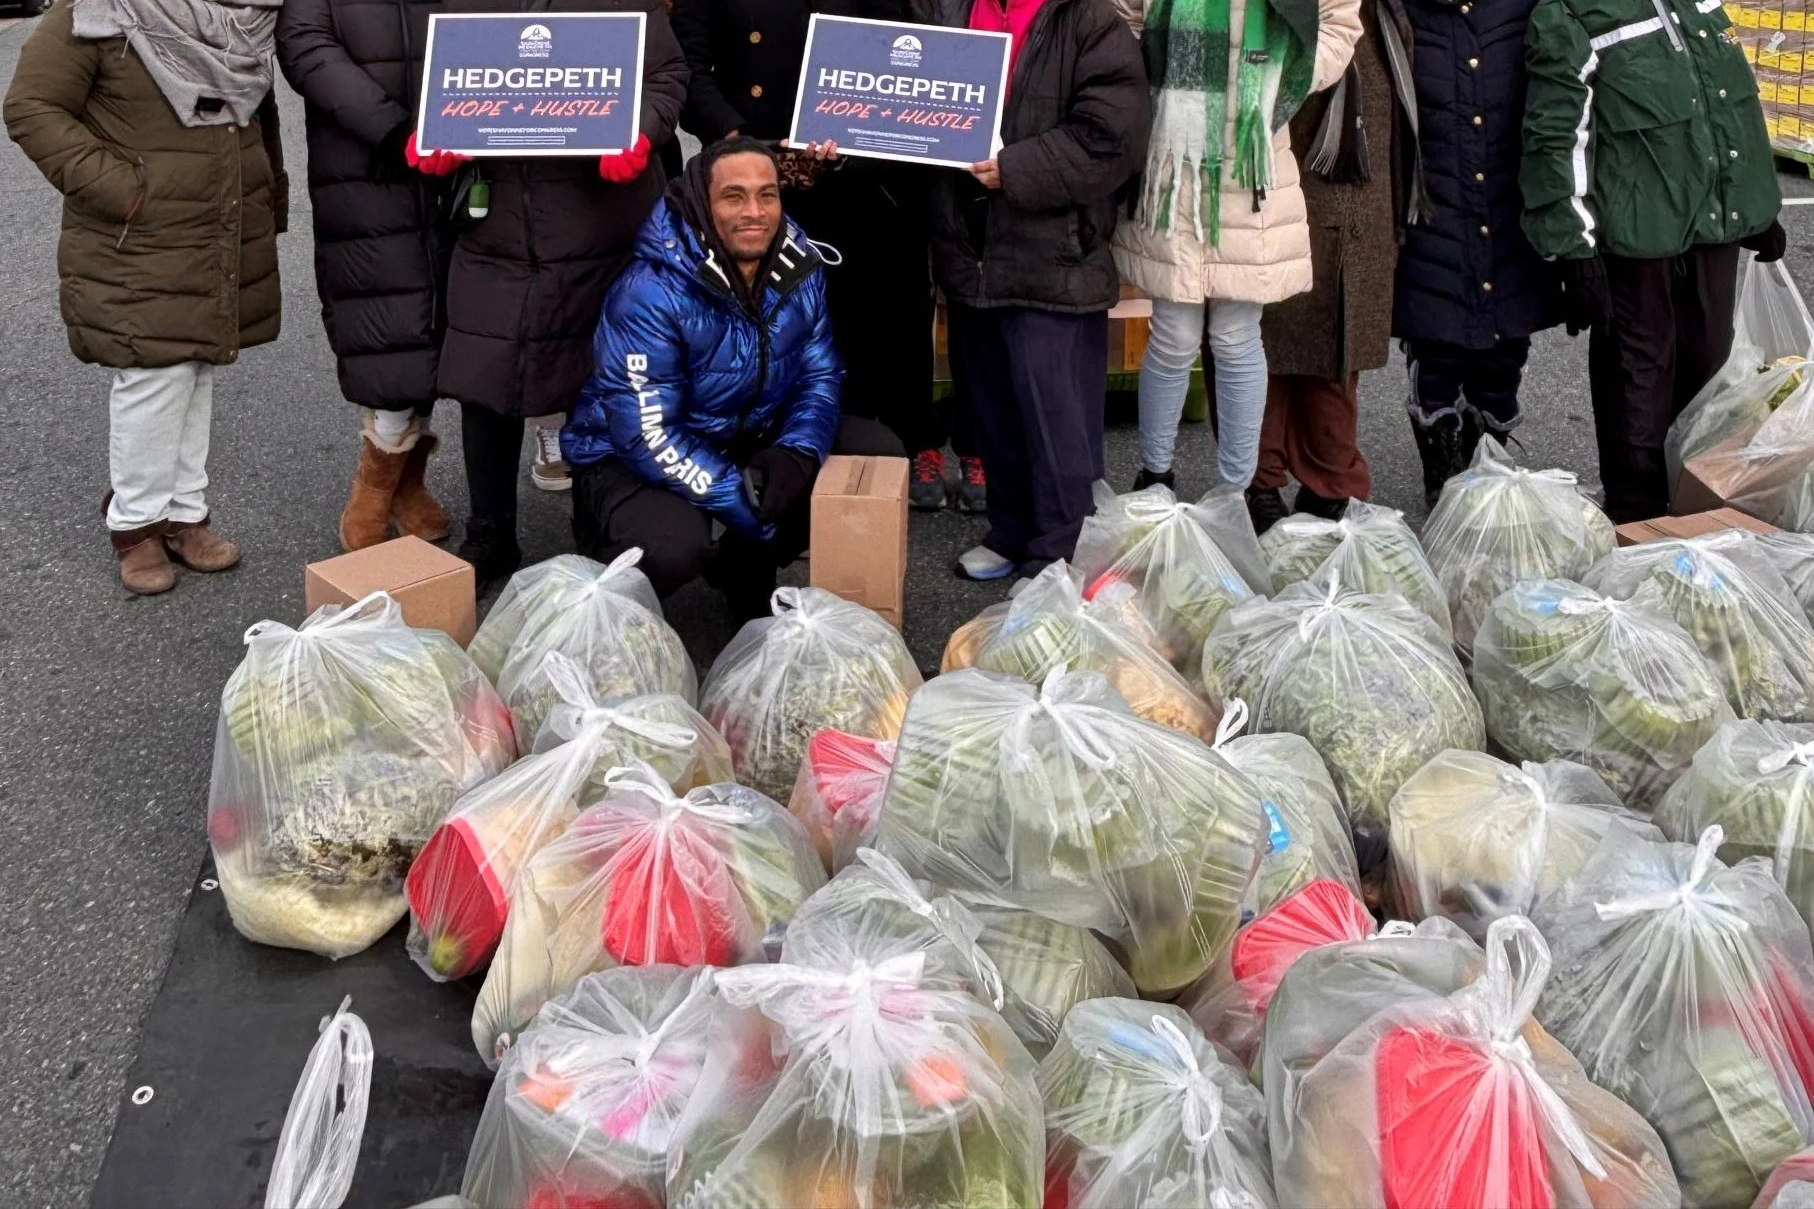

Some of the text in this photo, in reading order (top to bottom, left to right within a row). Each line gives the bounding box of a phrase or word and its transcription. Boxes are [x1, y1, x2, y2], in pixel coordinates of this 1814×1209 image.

[442, 67, 622, 89] HEDGEPETH
[818, 67, 986, 104] HEDGEPETH
[441, 99, 620, 117] HOPE + HUSTLE
[815, 99, 981, 130] HOPE + HUSTLE
